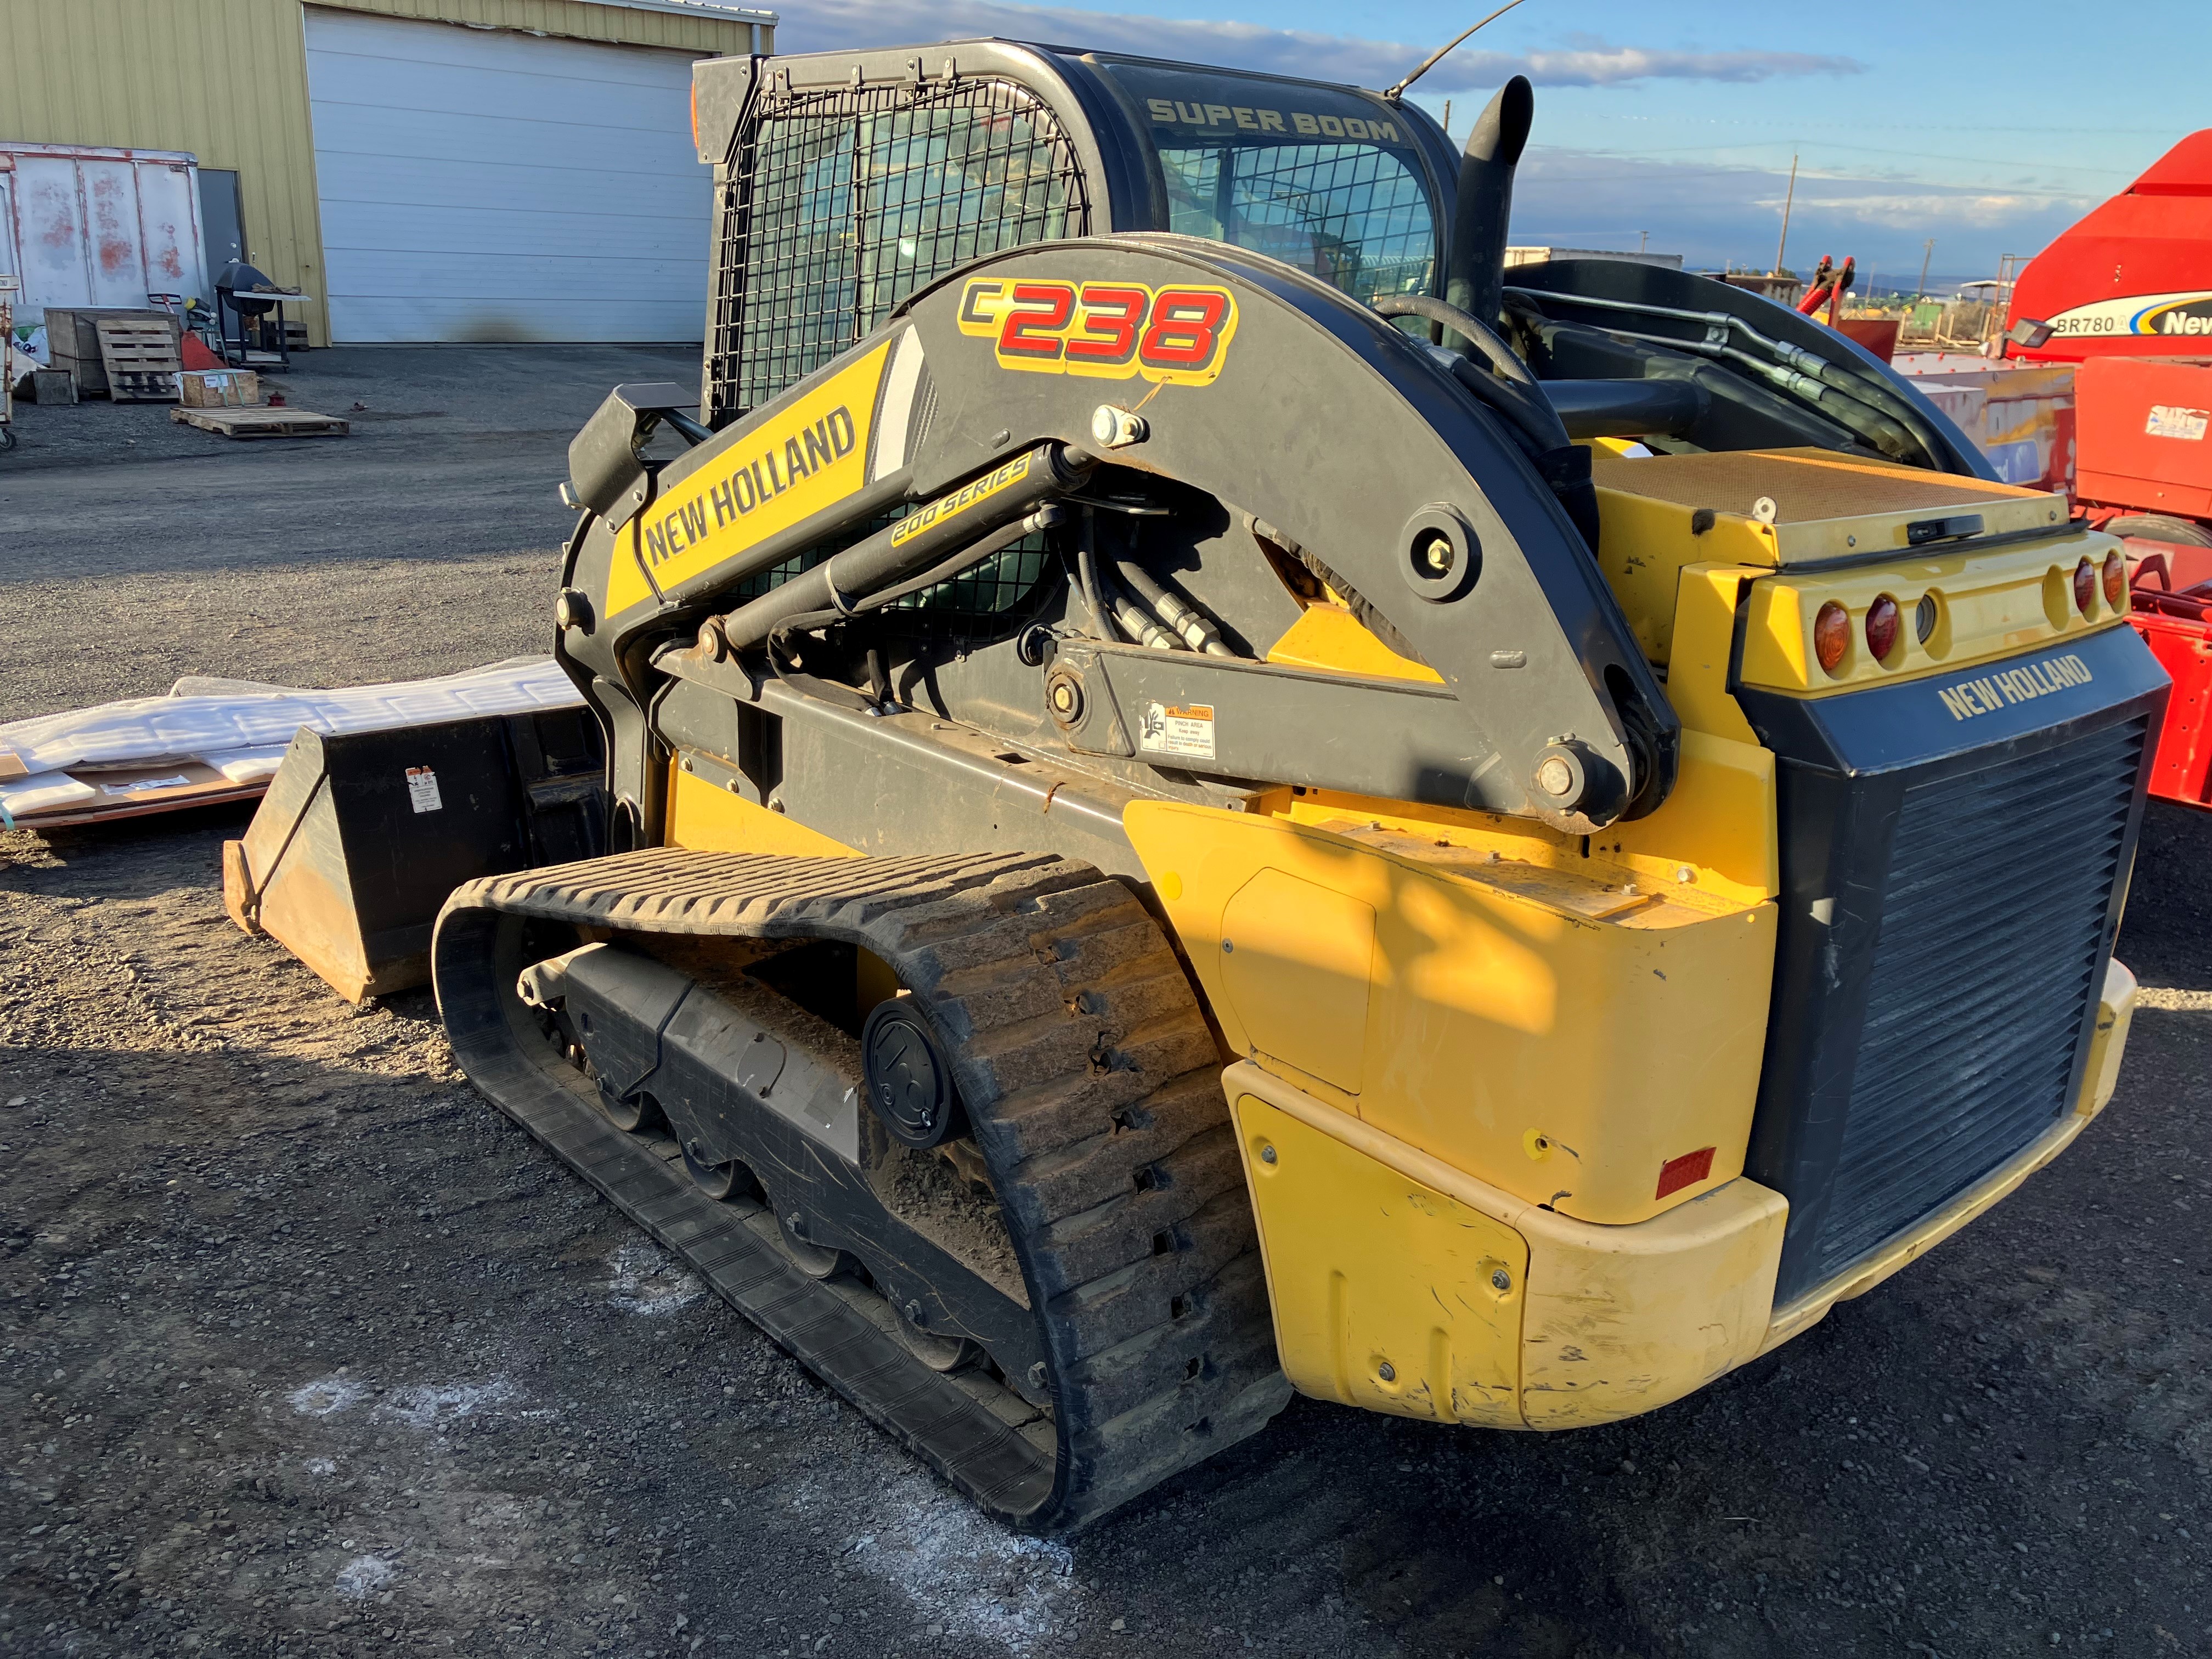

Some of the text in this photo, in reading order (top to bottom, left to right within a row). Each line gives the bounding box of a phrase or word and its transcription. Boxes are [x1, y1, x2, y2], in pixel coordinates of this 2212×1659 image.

[1147, 98, 1400, 143] SUPER BOOM
[960, 279, 1234, 374] C238
[645, 403, 857, 568] NEW HOLLAND
[893, 455, 1031, 543] 200 SERIES
[1938, 654, 2093, 721] NEW HOLLAND
